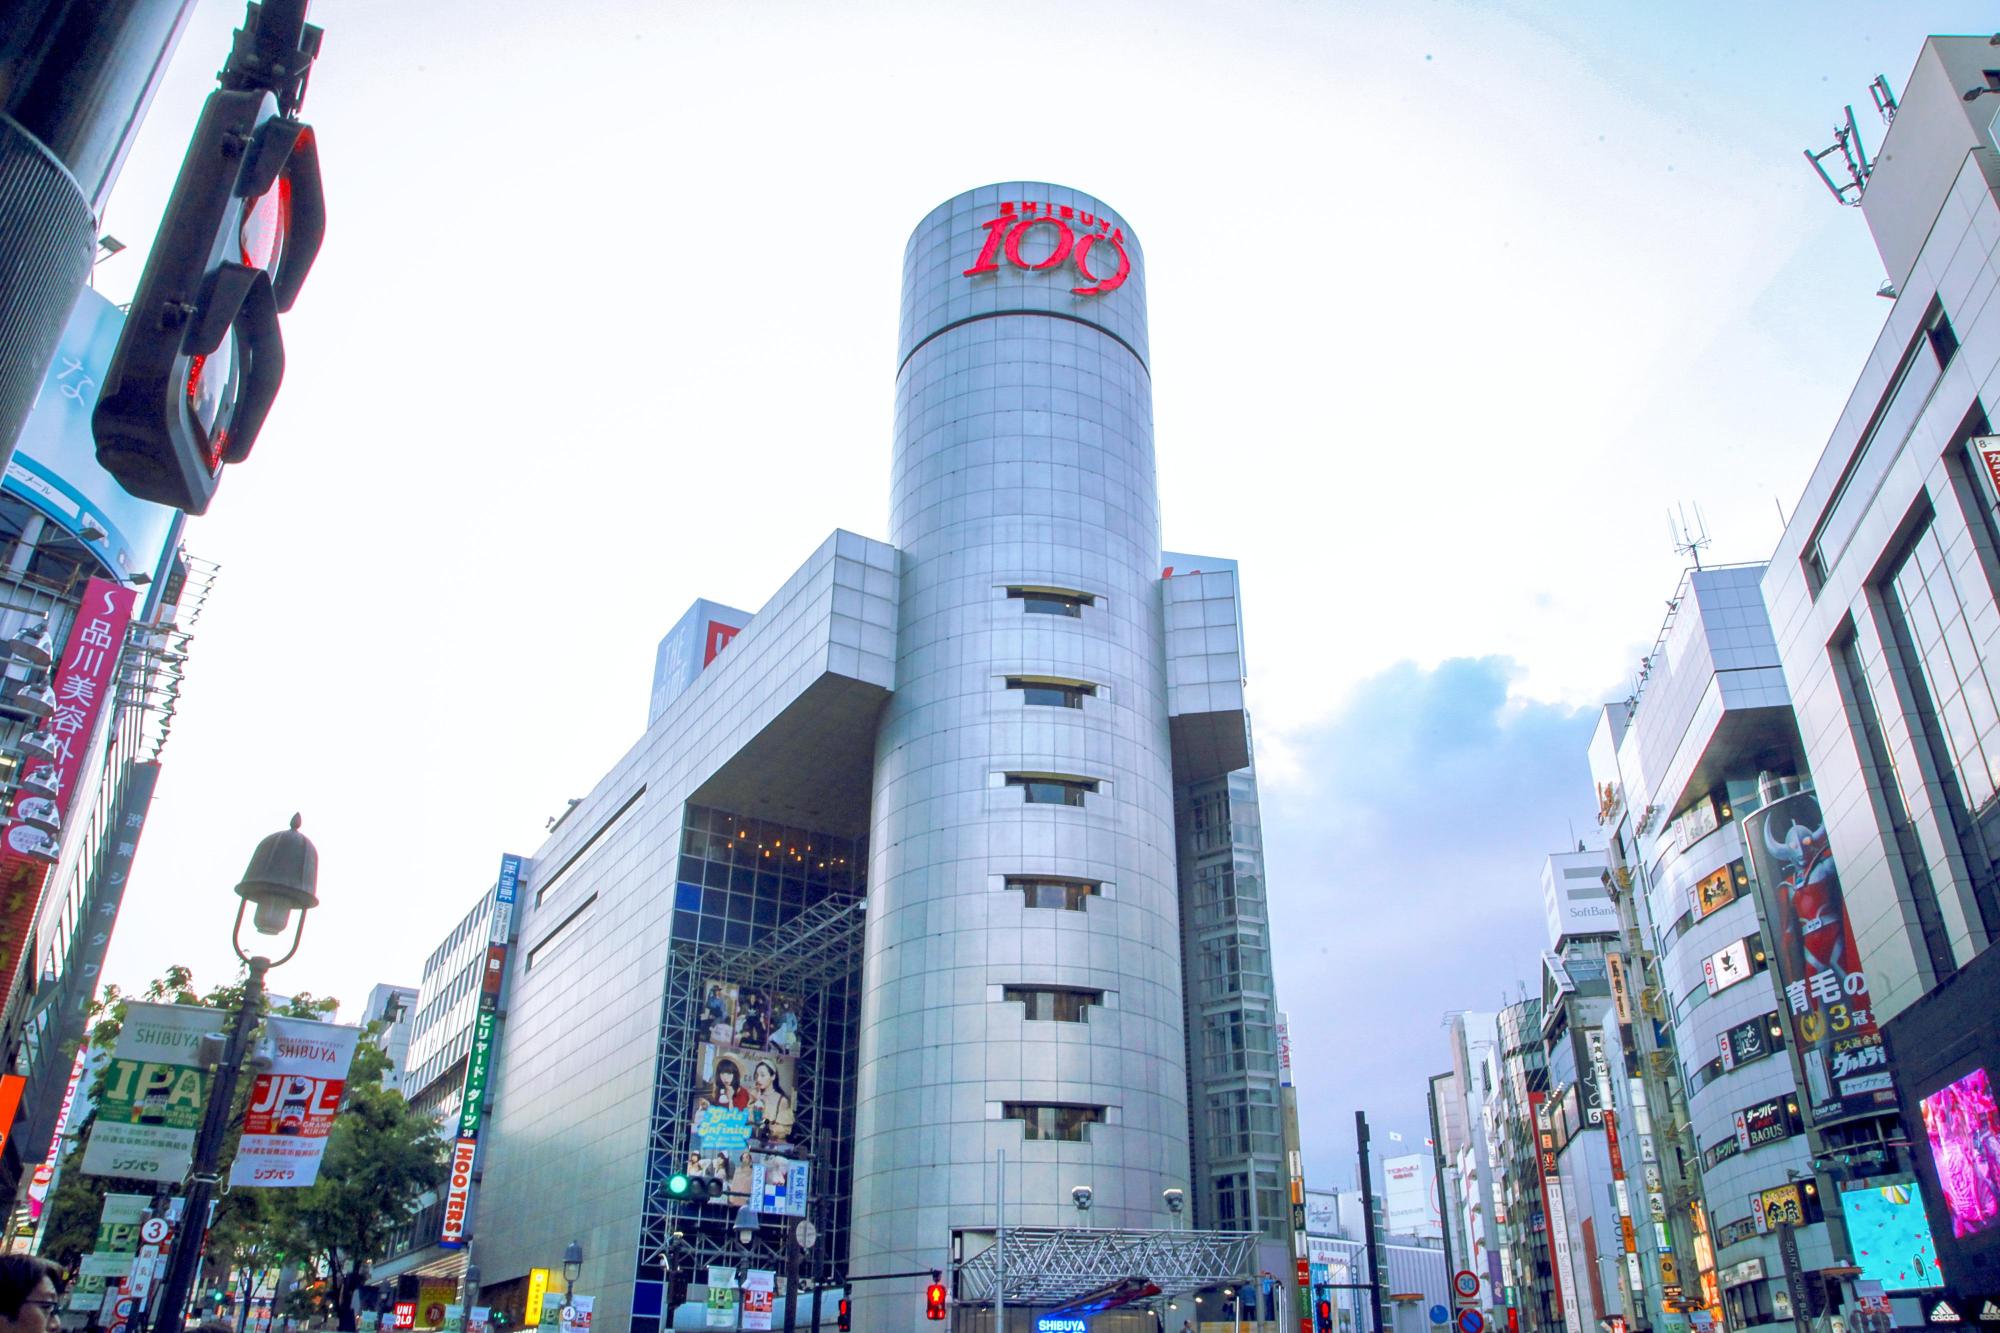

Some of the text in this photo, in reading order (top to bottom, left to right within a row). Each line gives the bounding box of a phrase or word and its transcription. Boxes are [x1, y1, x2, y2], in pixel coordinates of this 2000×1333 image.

[1001, 202, 1124, 243] SHIBUYA
[962, 214, 1130, 296] 109
[1569, 904, 1616, 918] SoftBank
[1785, 968, 1868, 1015] 育毛の
[135, 1028, 199, 1049] SHIBUYA
[278, 1044, 336, 1063] SHIBUYA
[463, 1013, 492, 1127] ビリヤード・ダーツ
[107, 1060, 201, 1108] IPA
[252, 1075, 336, 1118] JPL
[1590, 1111, 1599, 1121] 6
[1747, 1103, 1778, 1123] ダーツバー
[462, 1129, 474, 1138] 3F
[445, 1146, 475, 1234] HOOTERS
[1551, 1200, 1564, 1235] SoftBank
[148, 1222, 161, 1239] 3
[1786, 1241, 1798, 1267] SAINT
[1460, 1278, 1475, 1291] 30
[709, 1287, 733, 1303] IPA
[745, 1290, 772, 1306] JPL
[396, 1305, 413, 1314] UNI
[564, 1308, 572, 1318] 4
[1930, 1313, 1961, 1322] adidas
[395, 1315, 412, 1326] QLO
[1038, 1319, 1086, 1332] SHIBUYA
